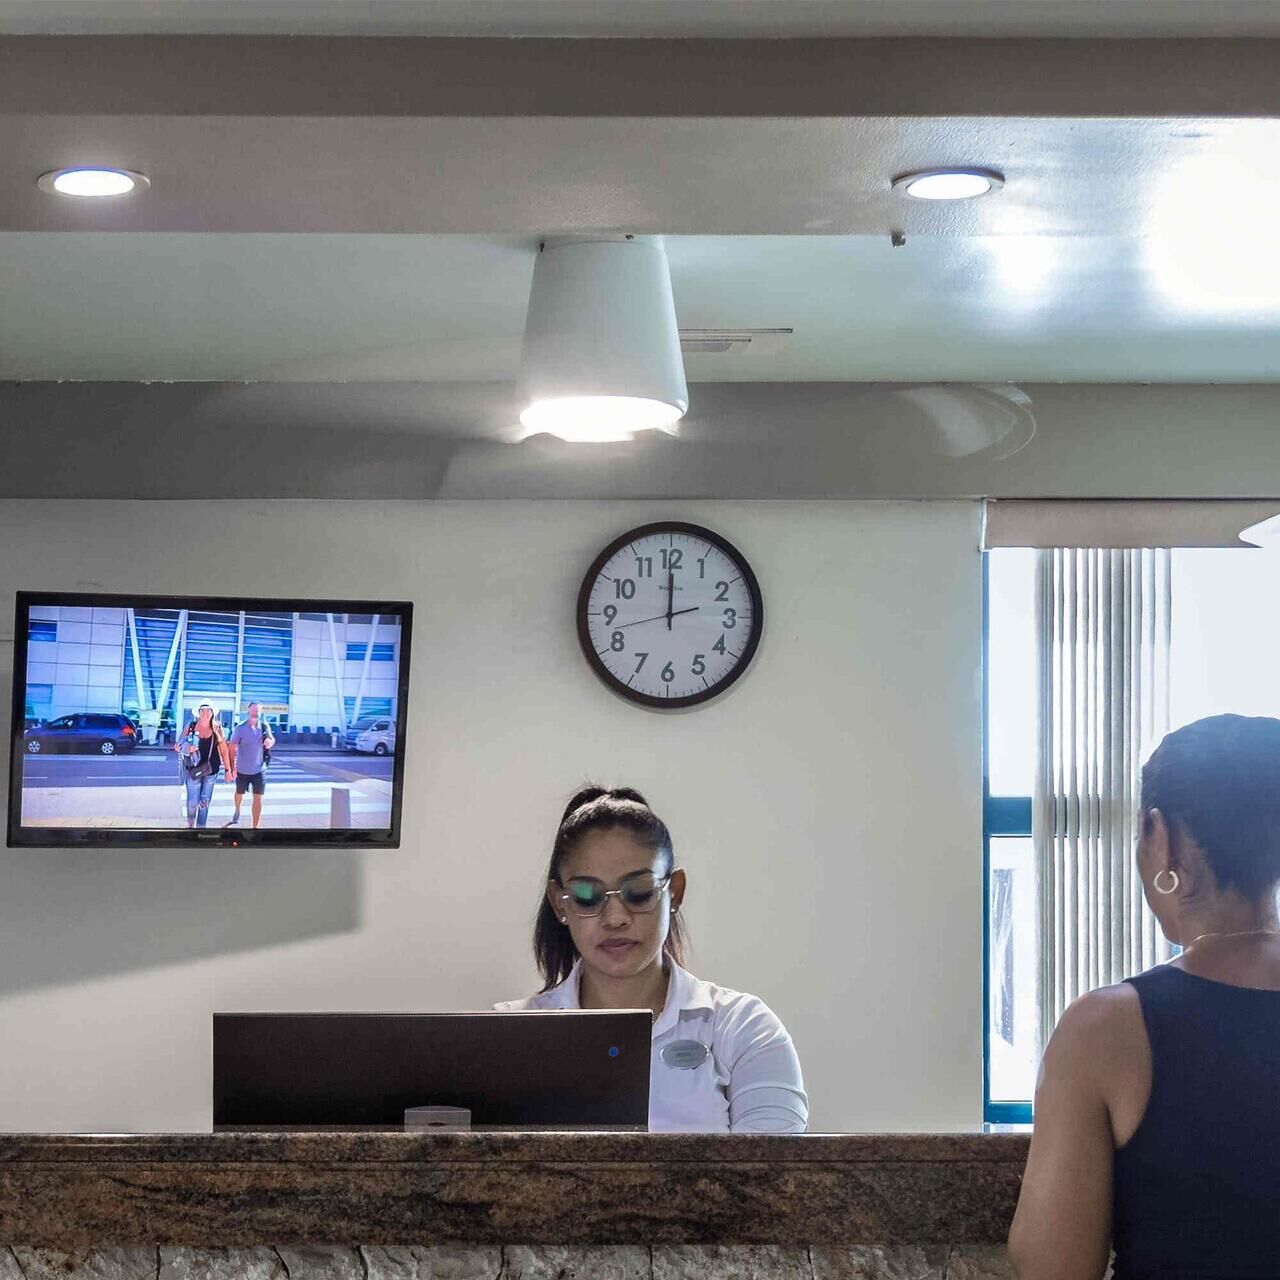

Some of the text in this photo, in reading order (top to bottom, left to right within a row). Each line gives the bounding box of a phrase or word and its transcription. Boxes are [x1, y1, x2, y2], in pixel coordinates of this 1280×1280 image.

[635, 557, 653, 577] 11
[659, 548, 683, 569] 12
[696, 558, 705, 579] 1
[613, 578, 636, 599] 10
[714, 581, 729, 602] 2
[603, 604, 617, 626] 9
[722, 608, 737, 629] 3
[611, 631, 624, 652] 8
[712, 633, 726, 656] 4
[635, 653, 648, 674] 7
[661, 661, 675, 682] 6
[691, 655, 705, 675] 5
